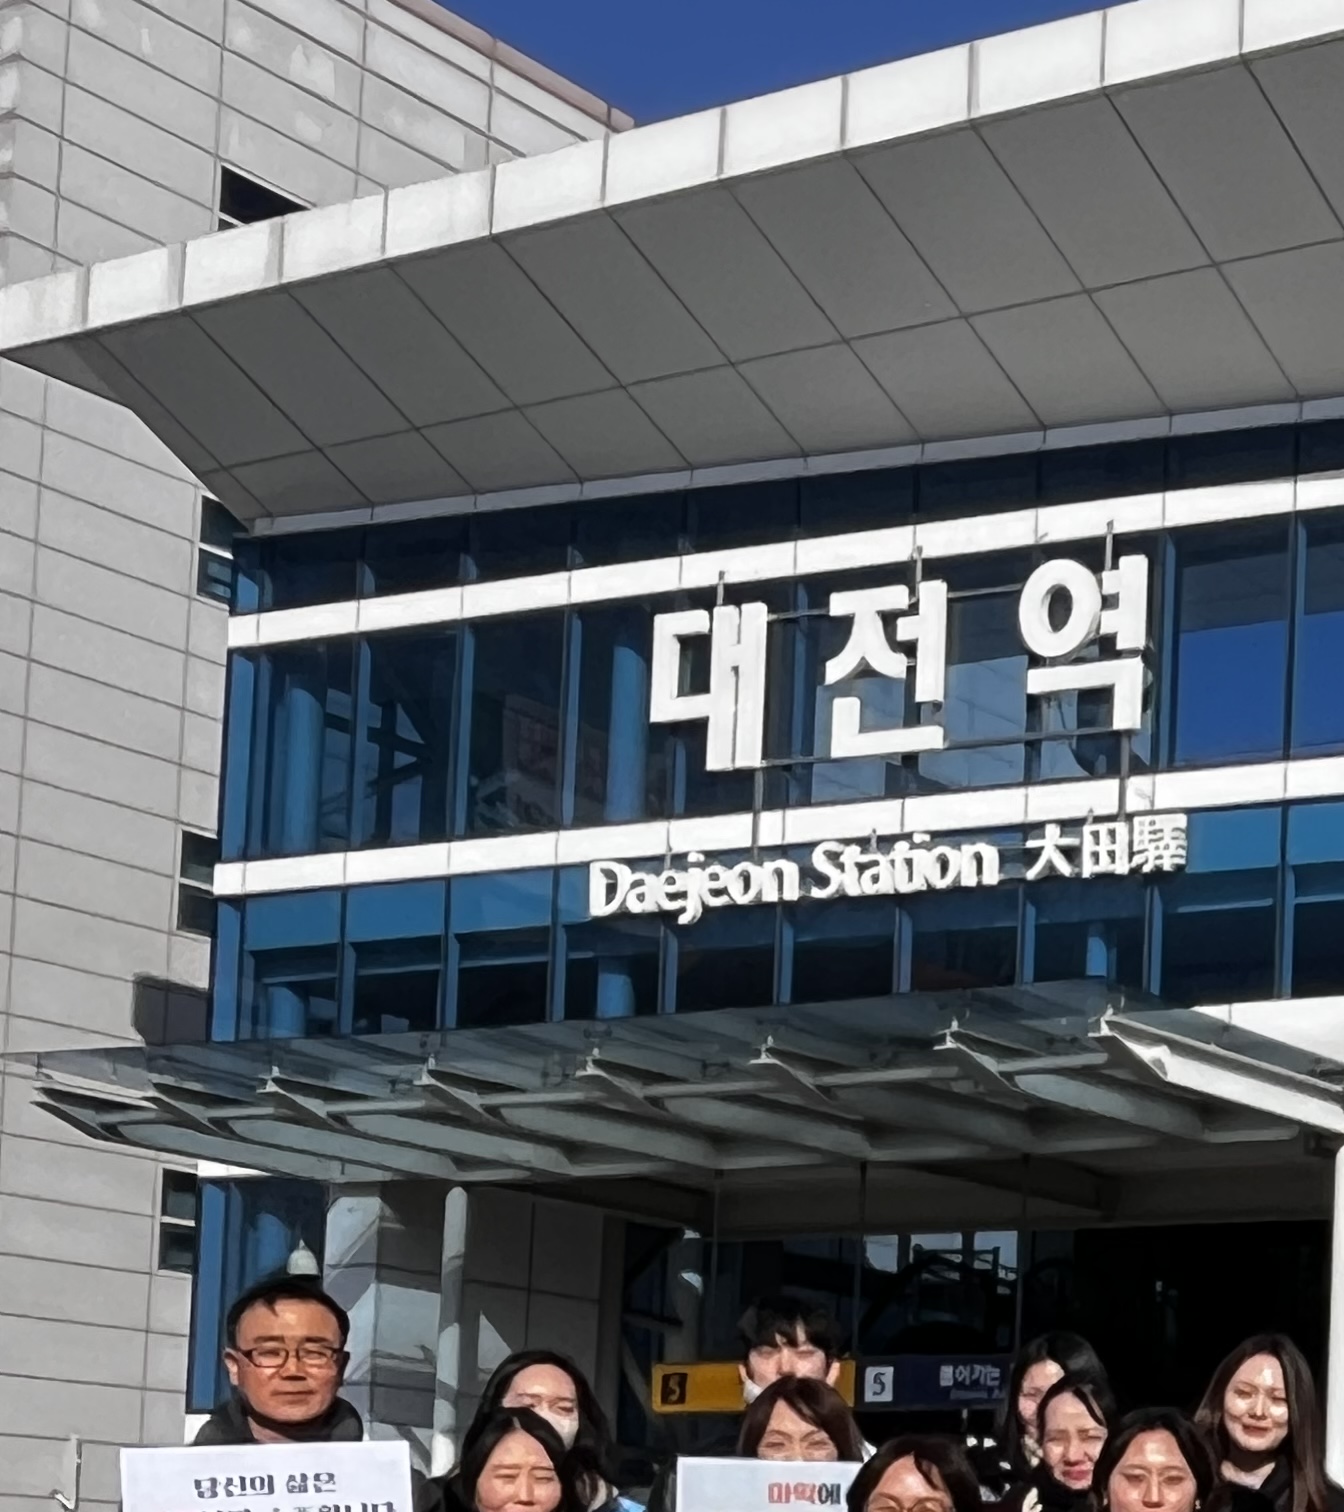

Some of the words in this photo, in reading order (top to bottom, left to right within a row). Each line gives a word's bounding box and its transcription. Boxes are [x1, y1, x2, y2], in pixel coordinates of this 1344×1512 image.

[649, 553, 1148, 771] 대전역
[589, 853, 801, 925] Daejeon
[811, 833, 1000, 899] Station
[1025, 812, 1188, 881] 大田驛
[194, 1474, 275, 1499] 당신의
[286, 1472, 337, 1494] 삶은
